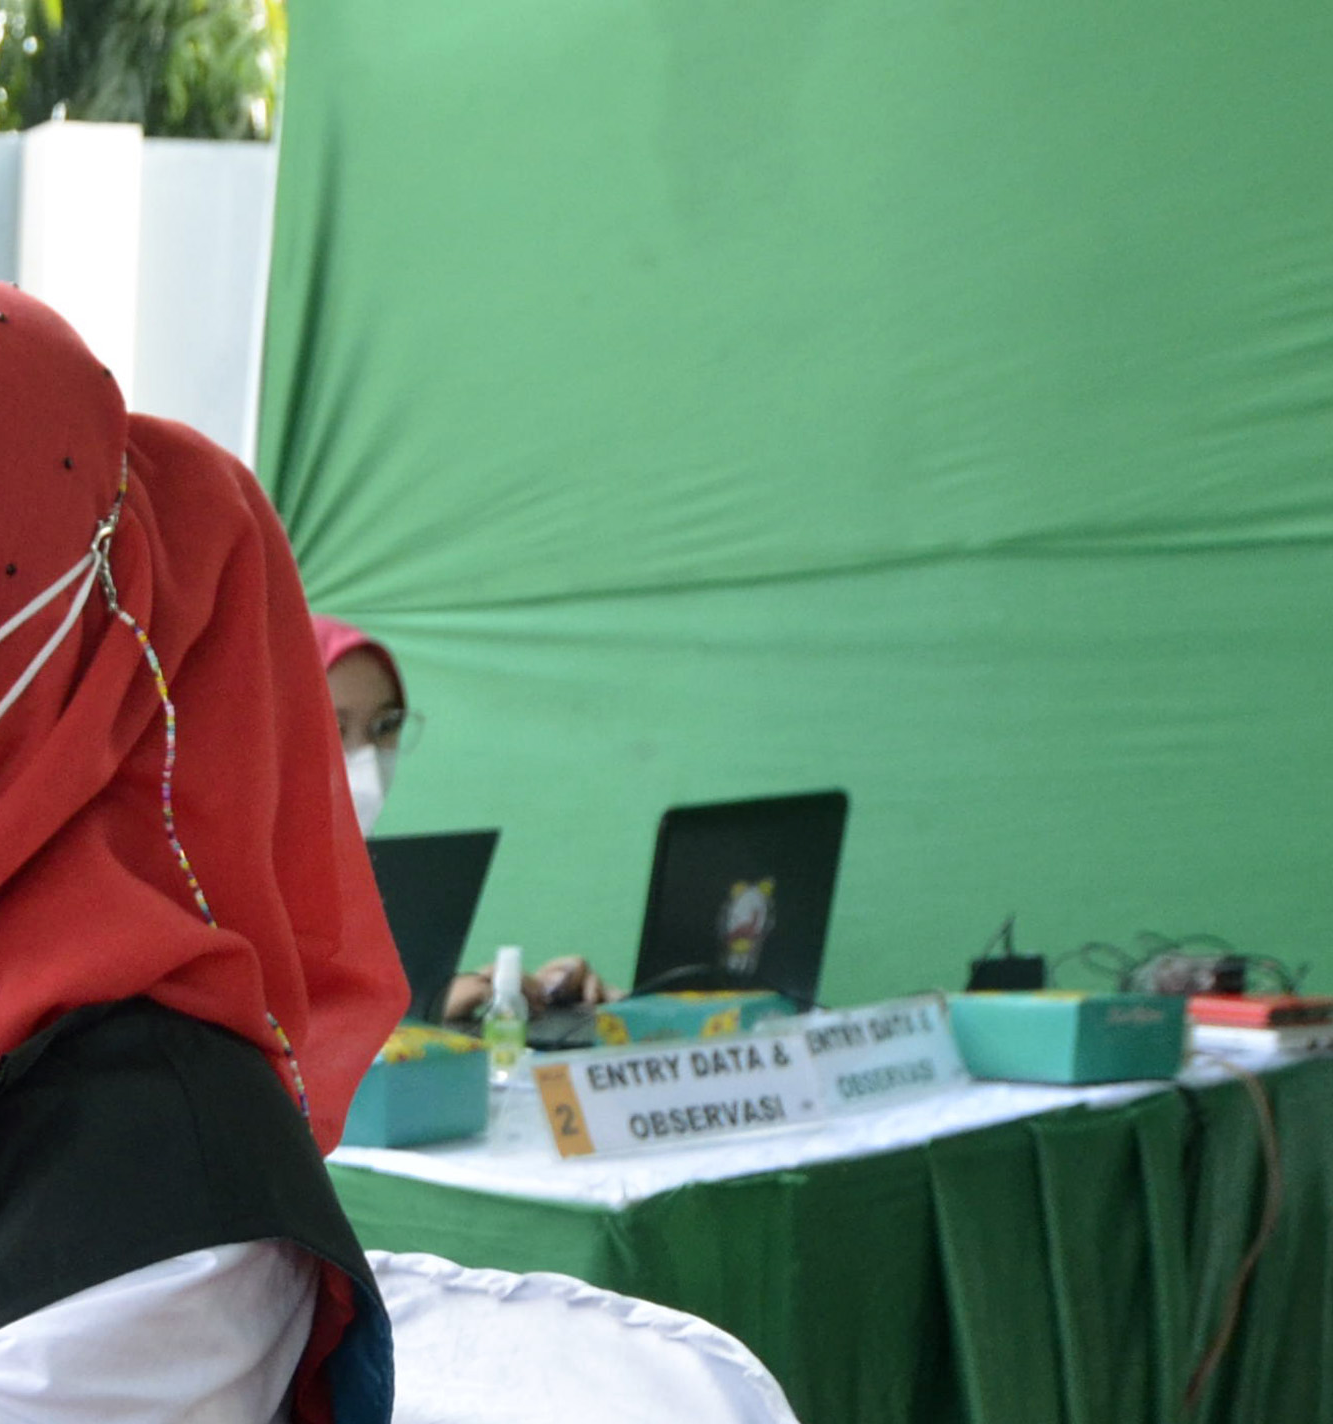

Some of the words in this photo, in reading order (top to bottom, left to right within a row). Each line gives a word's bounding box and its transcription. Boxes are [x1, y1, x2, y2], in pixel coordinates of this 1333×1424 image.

[585, 1048, 680, 1092] ENTRY
[689, 1041, 764, 1079] DATA
[771, 1038, 792, 1068] &
[555, 1103, 580, 1136] 2
[628, 1094, 786, 1141] OBSERVASI
